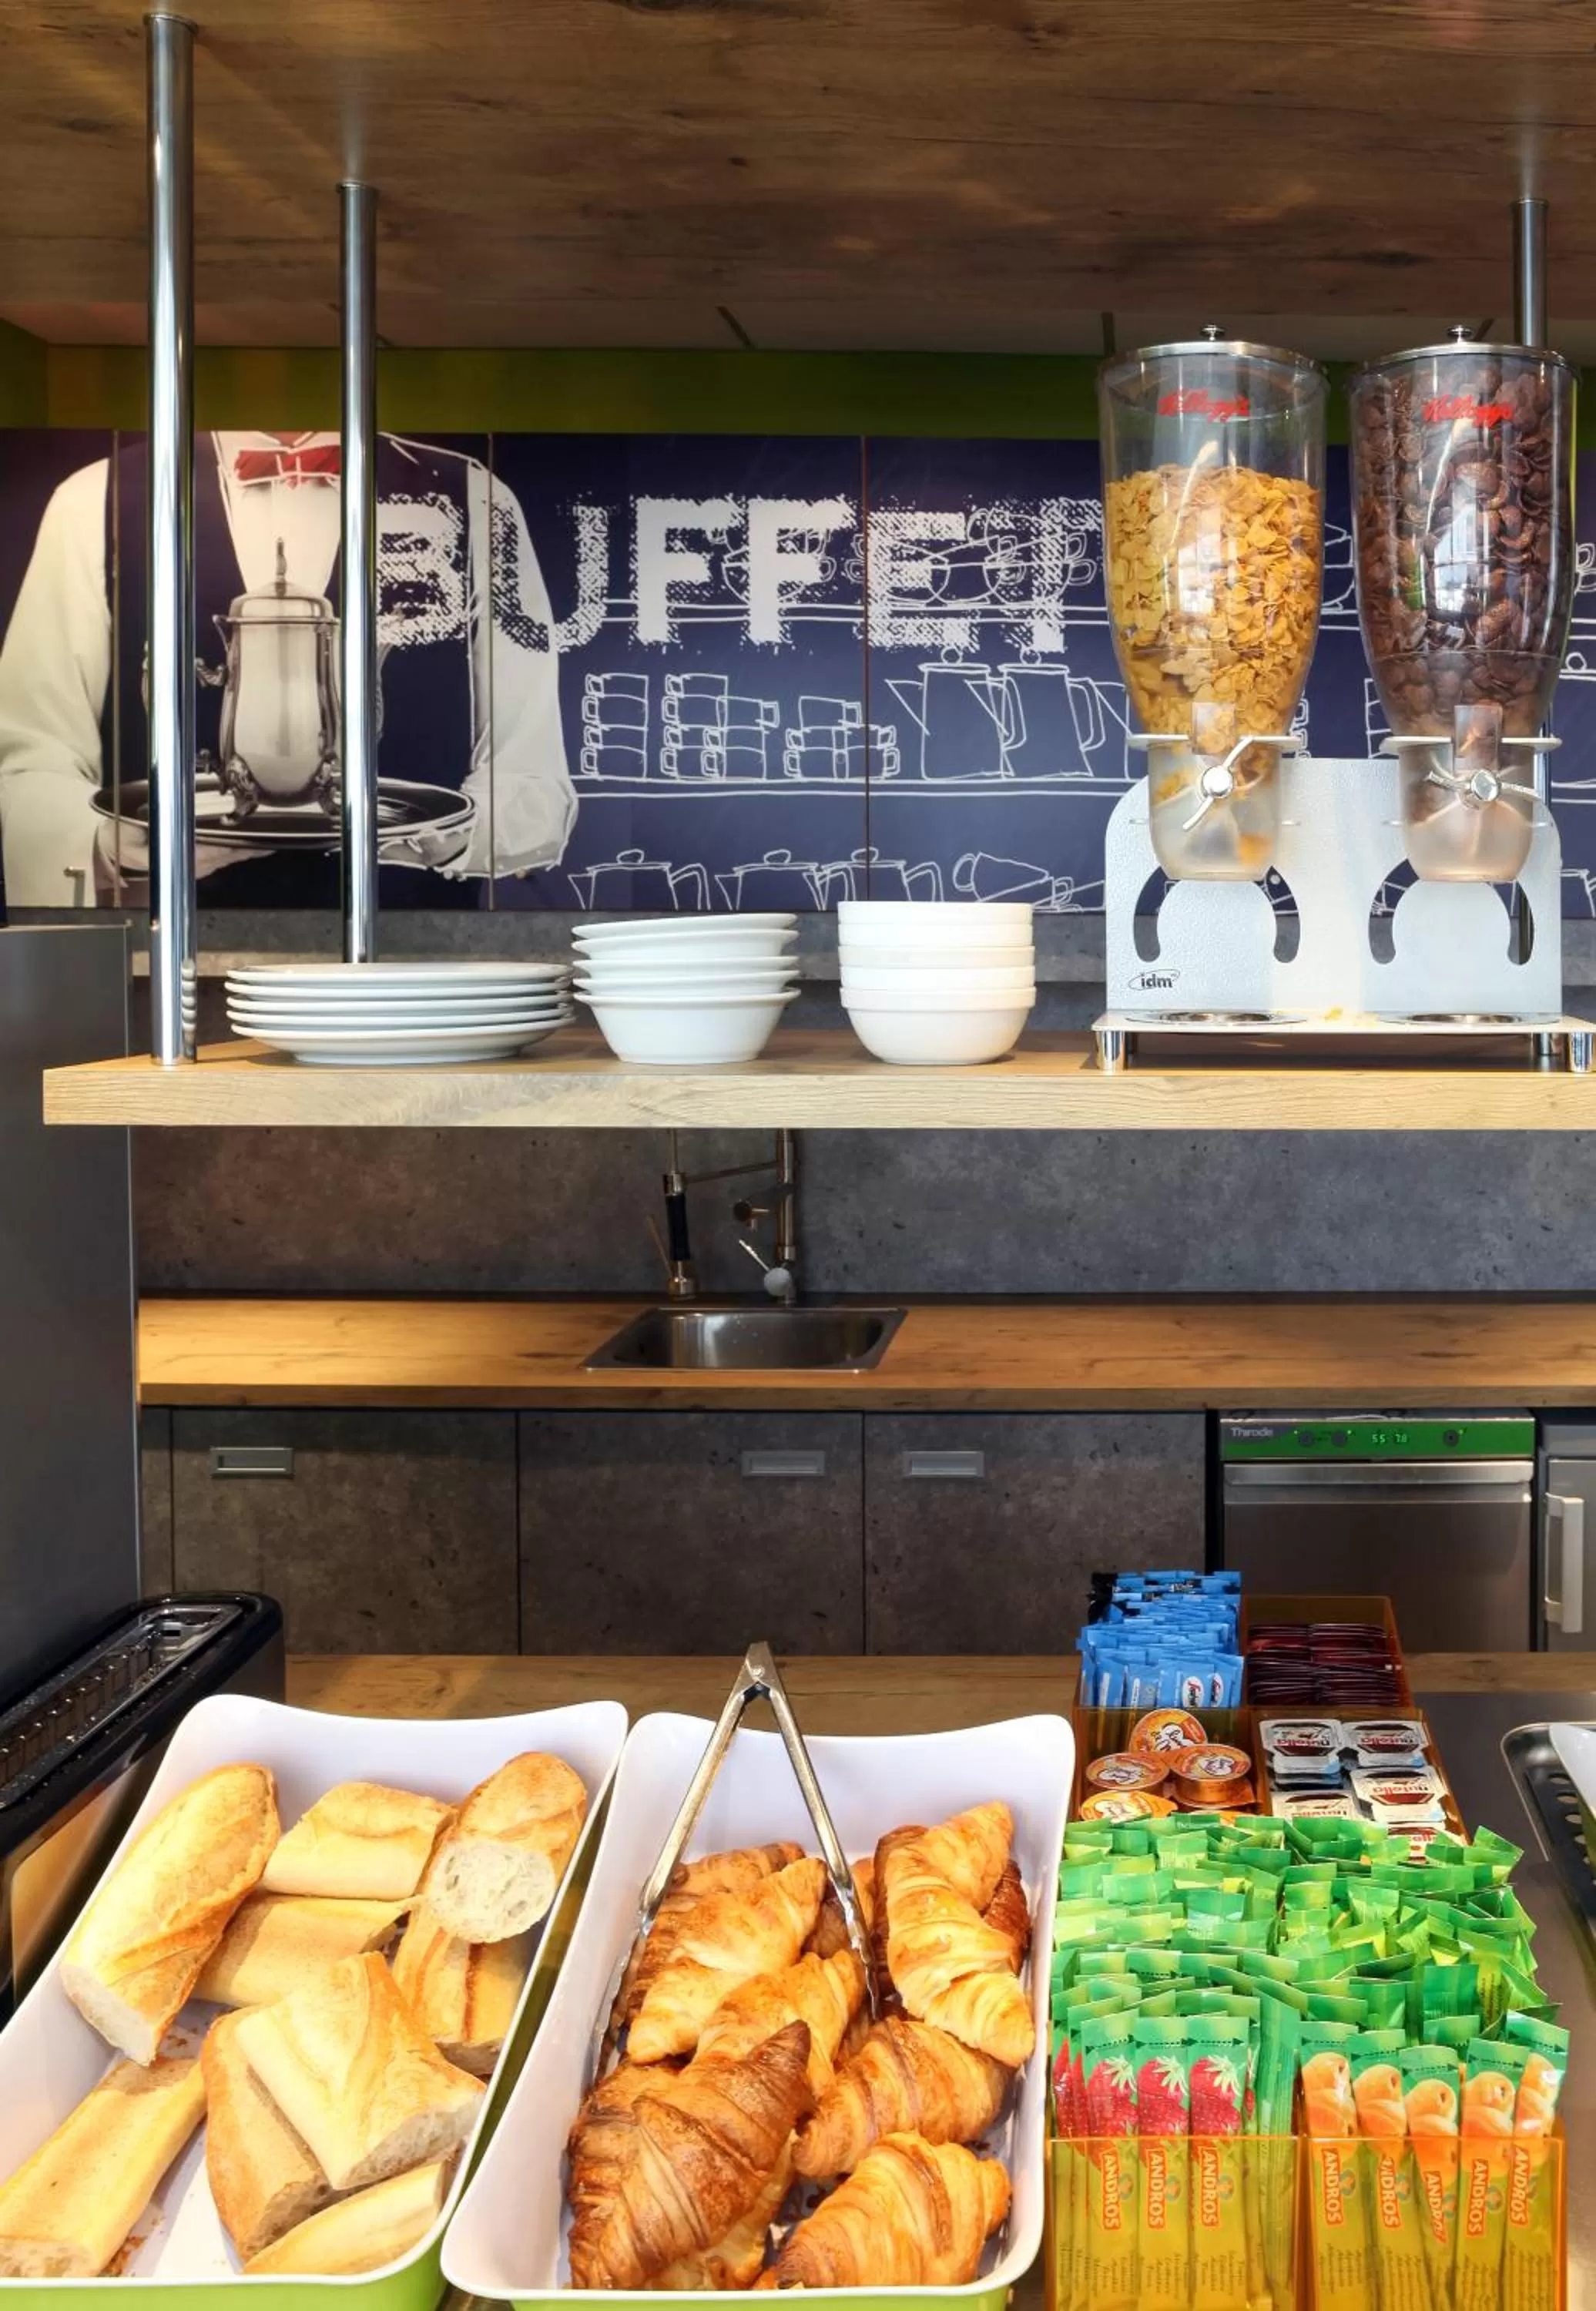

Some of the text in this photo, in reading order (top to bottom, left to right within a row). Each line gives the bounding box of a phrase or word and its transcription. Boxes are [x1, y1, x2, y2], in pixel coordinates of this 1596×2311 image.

[1140, 974, 1172, 988] idm
[1373, 1786, 1429, 1796] nutella
[1103, 2155, 1119, 2228] ANDROS
[1148, 2152, 1164, 2226] ANDROS
[1203, 2151, 1218, 2225] ANDROS
[1326, 2151, 1343, 2223] ANDROS
[1467, 2161, 1487, 2232] ANDROS
[1511, 2147, 1529, 2223] ANDROS
